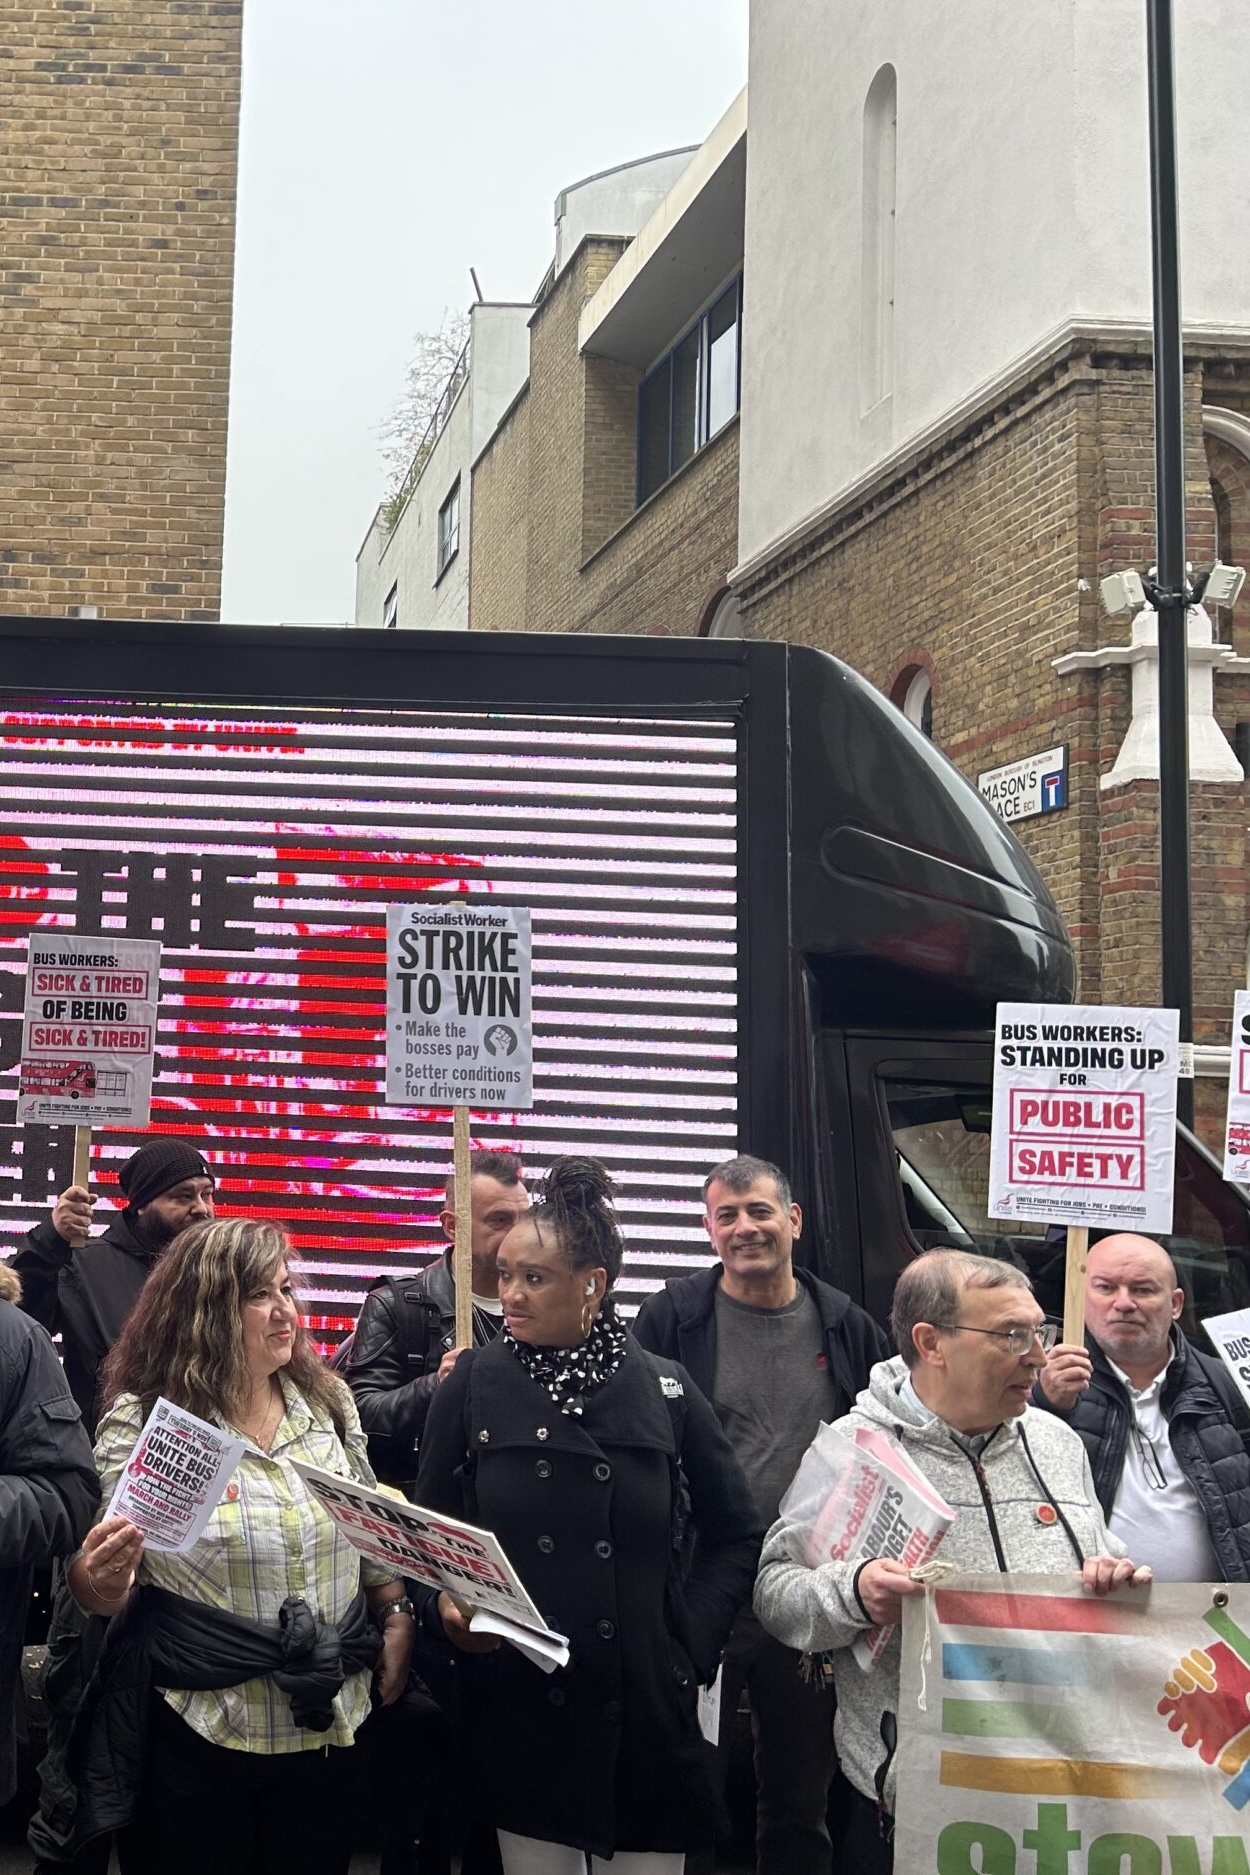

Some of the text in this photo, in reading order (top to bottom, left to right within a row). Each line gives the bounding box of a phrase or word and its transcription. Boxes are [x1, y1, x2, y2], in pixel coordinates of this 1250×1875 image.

[982, 771, 1037, 801] MASON'S
[996, 797, 1020, 818] ACE
[33, 953, 119, 967] BUS WORKERS:
[397, 928, 519, 973] STRIKE
[37, 973, 143, 994] SICK & TIRED
[396, 973, 520, 1018] TO WIN
[42, 1000, 127, 1021] OF BEING
[34, 1028, 146, 1048] SICK & TIRED!
[405, 1021, 466, 1038] Make the
[1001, 1024, 1142, 1043] BUS WORKERS:
[405, 1039, 479, 1060] bosses pay
[1000, 1045, 1124, 1069] STANDING
[1130, 1048, 1165, 1070] UP
[405, 1062, 521, 1083] Better conditions
[1059, 1073, 1087, 1086] FOR
[404, 1081, 506, 1100] for drivers now
[1019, 1099, 1134, 1130] PUBLIC
[1017, 1148, 1134, 1180] SAFETY
[146, 1436, 187, 1467] UNITE
[186, 1457, 215, 1482] BUS
[154, 1426, 202, 1458] ATTENTION
[201, 1452, 219, 1467] ALL
[143, 1451, 204, 1494] DRIVERS!
[128, 1484, 191, 1523] MARCH AND RALLY
[307, 1477, 488, 1560] STOP THE
[830, 1465, 879, 1561] Socialist
[860, 1485, 904, 1558] ABOUR'S
[880, 1513, 913, 1560] DGET
[336, 1506, 495, 1579] FATIGUE
[902, 1526, 930, 1570] ALTH
